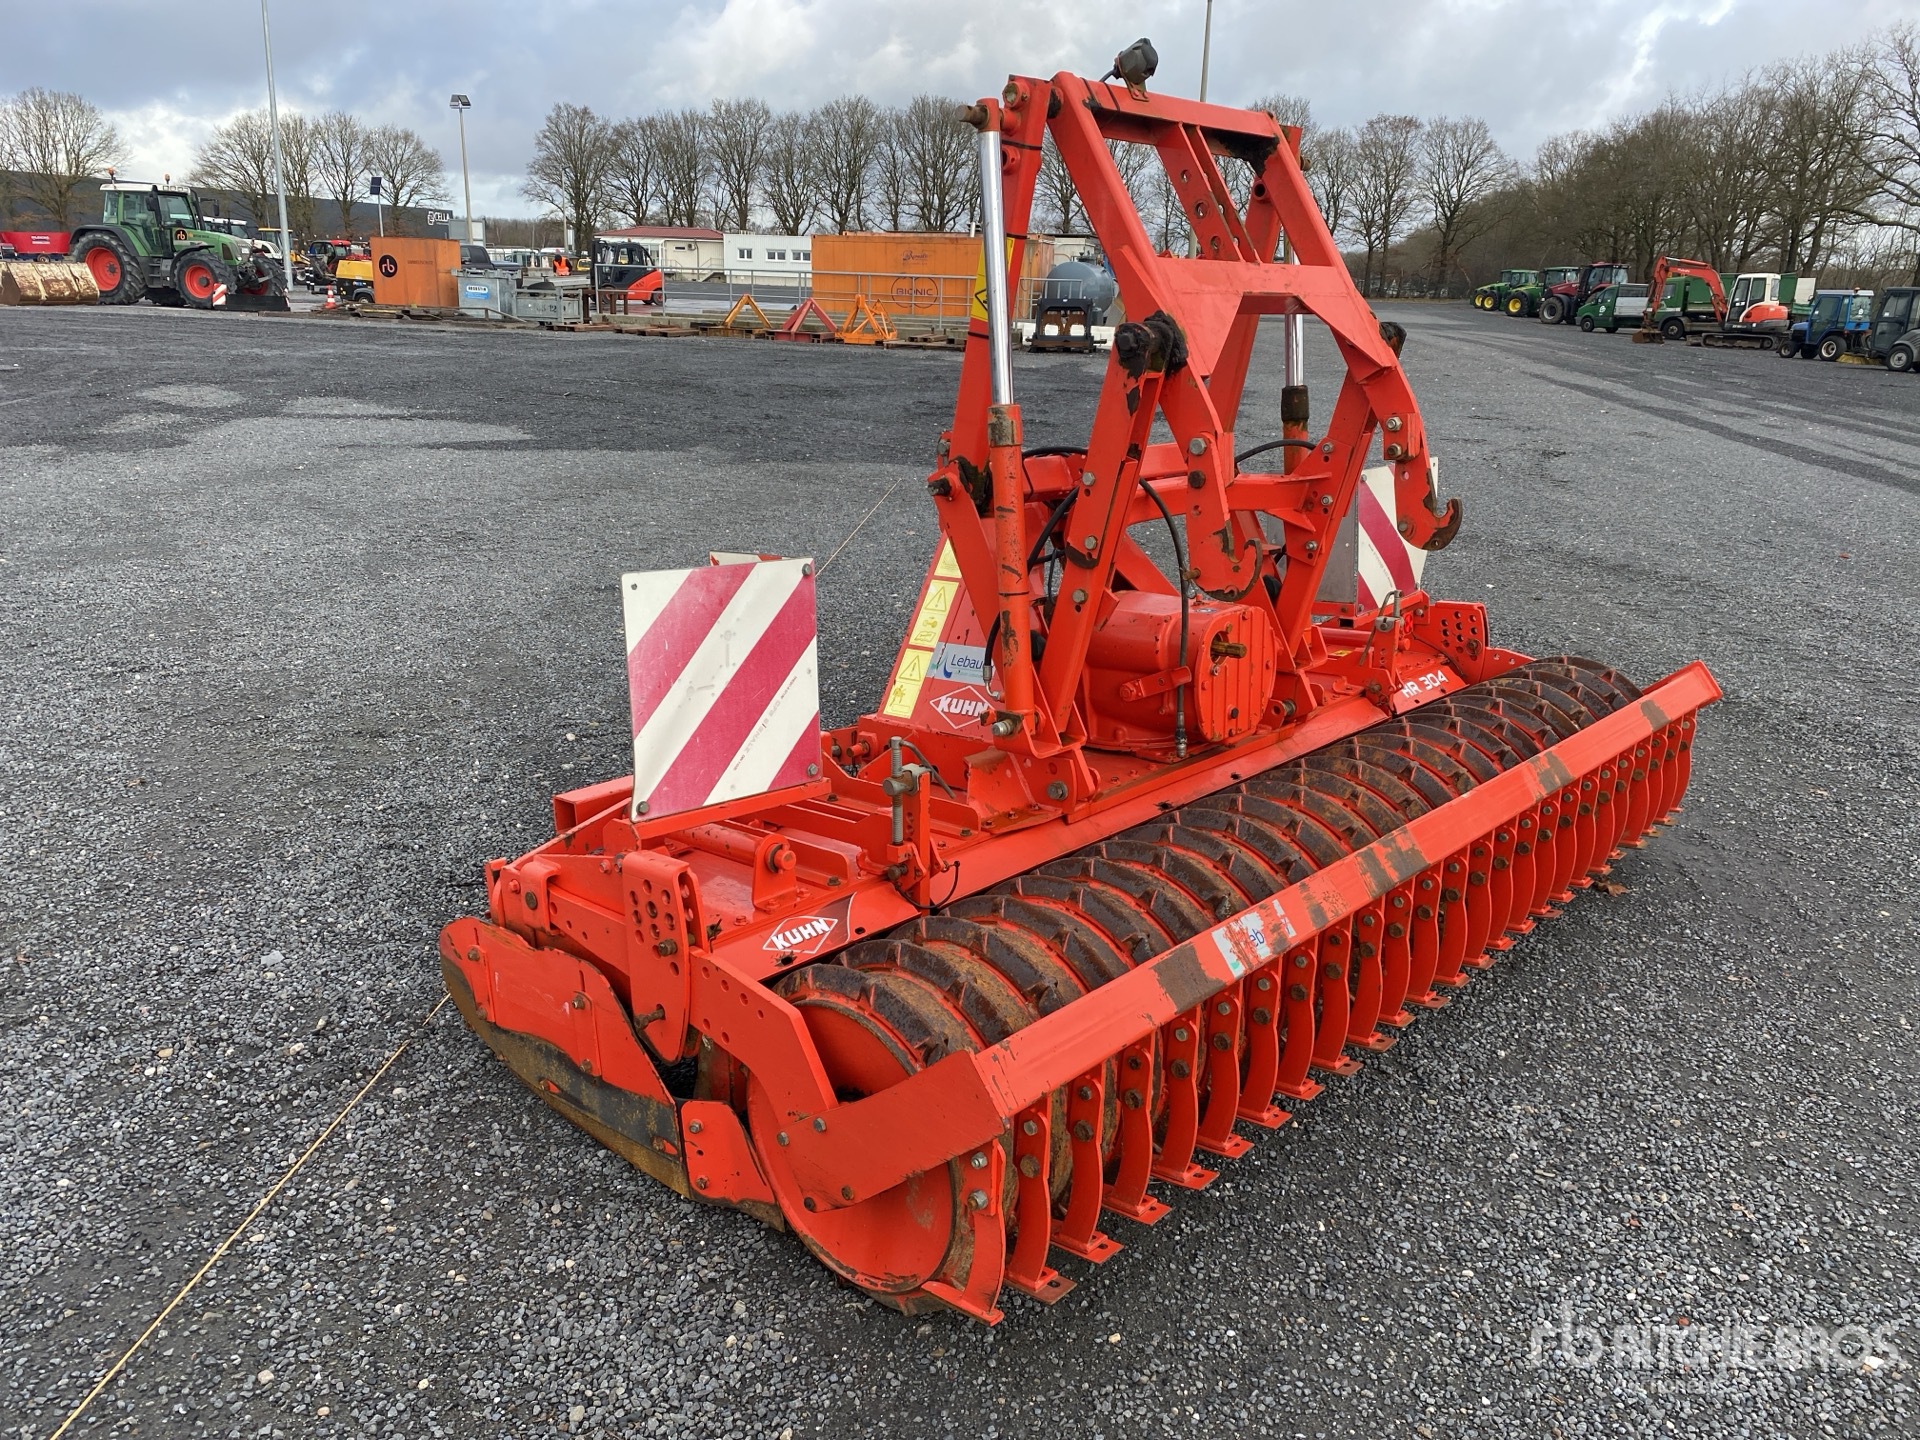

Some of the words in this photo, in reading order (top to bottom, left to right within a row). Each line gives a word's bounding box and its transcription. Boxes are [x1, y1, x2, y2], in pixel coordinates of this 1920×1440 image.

[381, 258, 396, 273] rb
[896, 287, 934, 297] BIONIC
[950, 653, 985, 670] Lebau
[1418, 669, 1449, 691] 304
[937, 695, 990, 717] KUHN
[771, 917, 831, 950] KUHN
